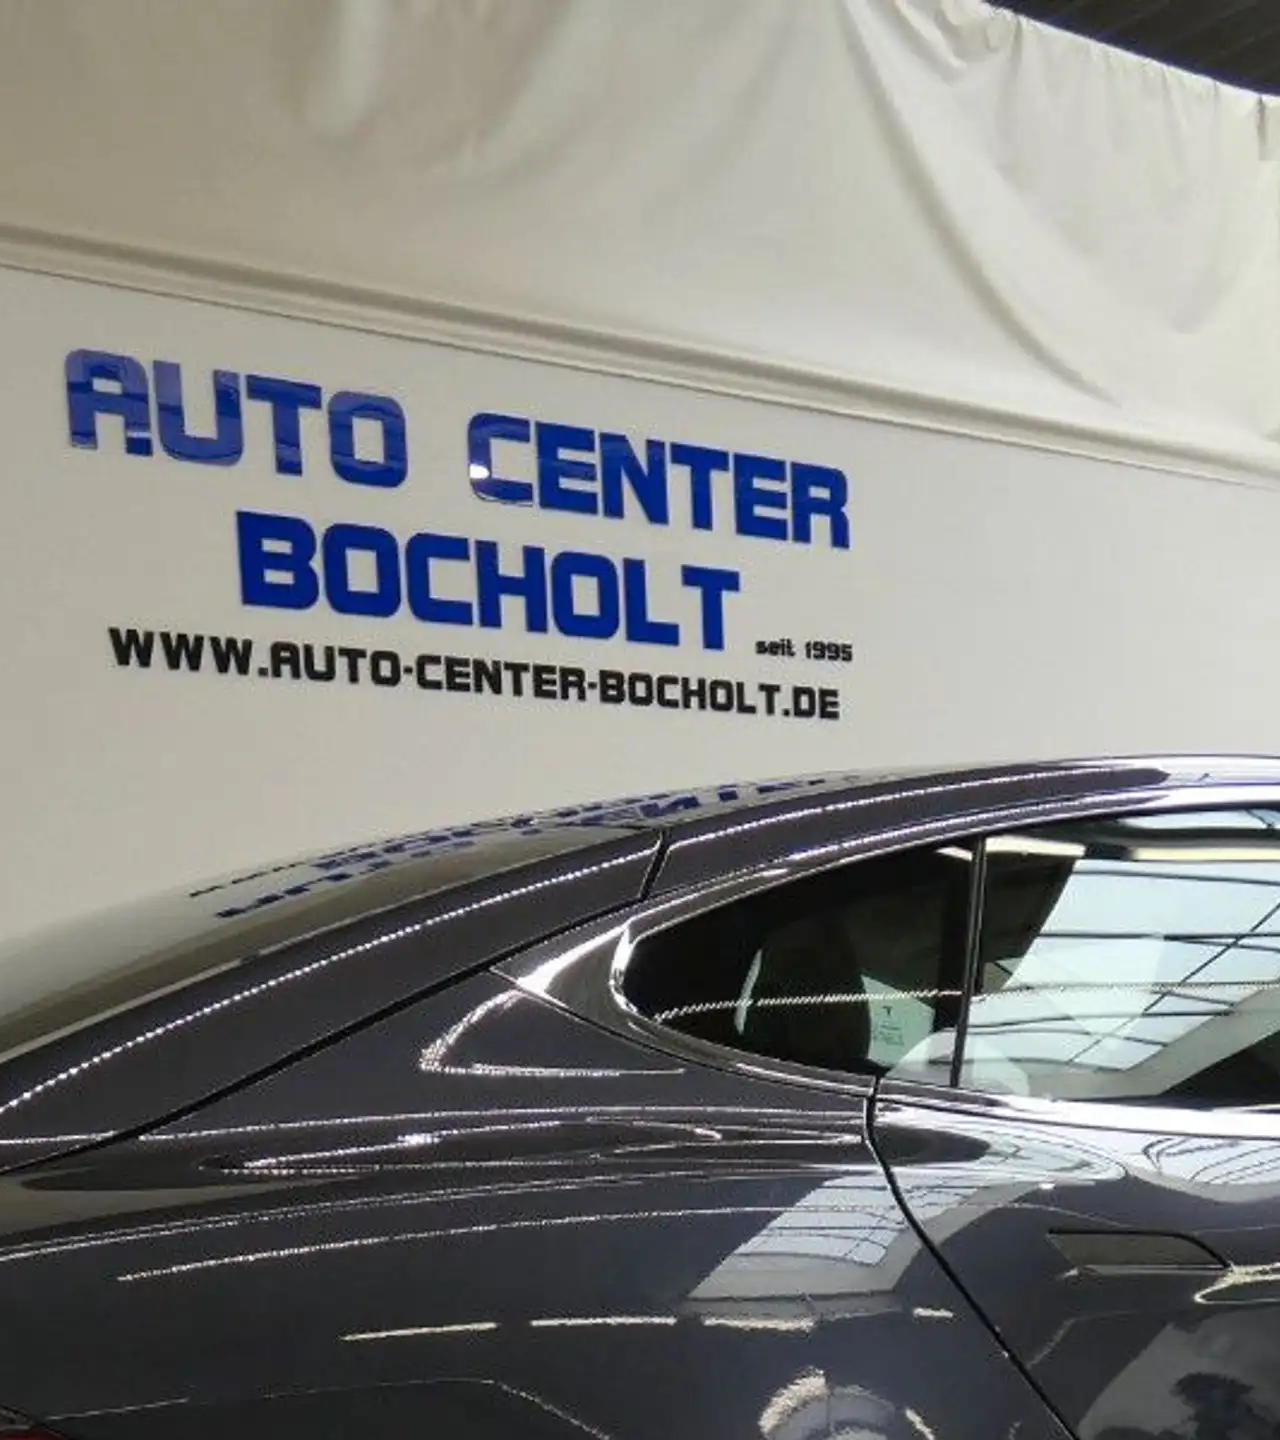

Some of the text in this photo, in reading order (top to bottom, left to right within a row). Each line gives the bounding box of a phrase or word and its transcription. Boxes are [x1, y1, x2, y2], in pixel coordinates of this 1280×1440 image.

[66, 349, 851, 550] AUTO CENTER
[237, 511, 741, 652] BOCHOLT
[108, 627, 840, 720] WWW.AUTO-CENTER-BOCHOLT.DE
[755, 638, 853, 662] seit 1995
